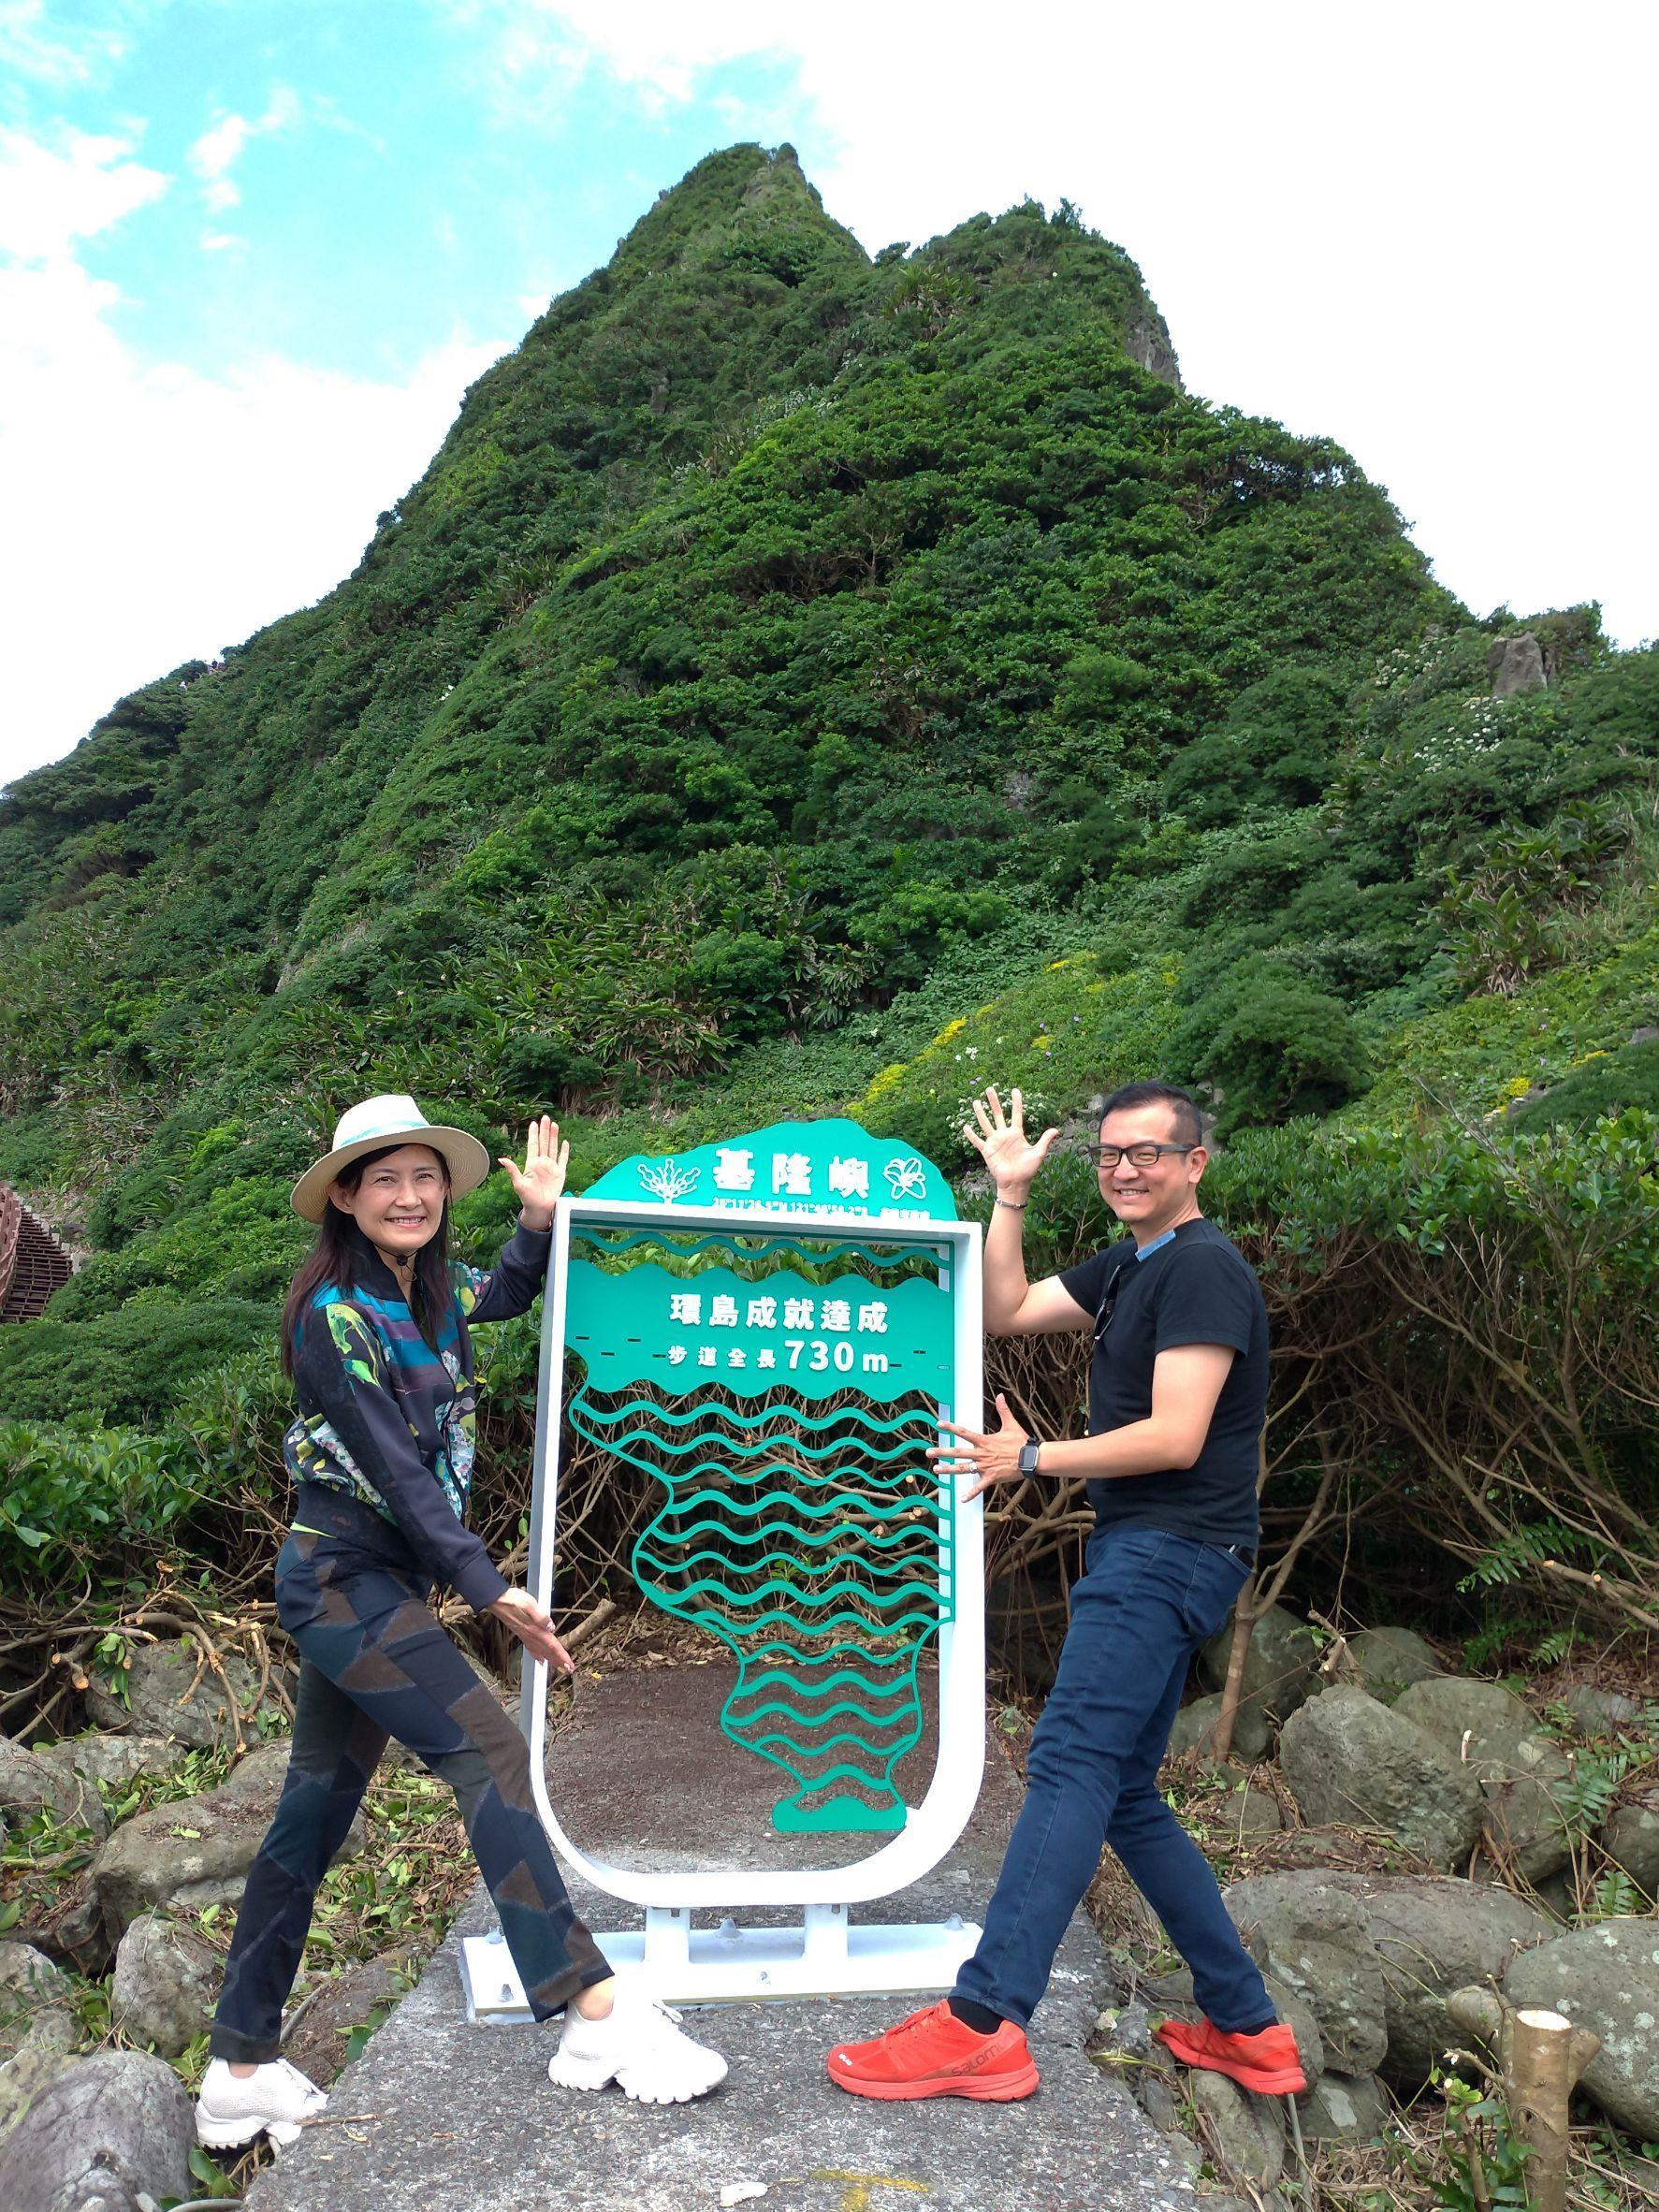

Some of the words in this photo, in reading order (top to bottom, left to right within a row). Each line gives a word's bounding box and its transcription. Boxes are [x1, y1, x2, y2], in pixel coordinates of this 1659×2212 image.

[712, 1147, 870, 1200] 基隆嶼
[669, 1293, 889, 1333] 環島成就達成
[667, 1345, 777, 1369] 步道全長
